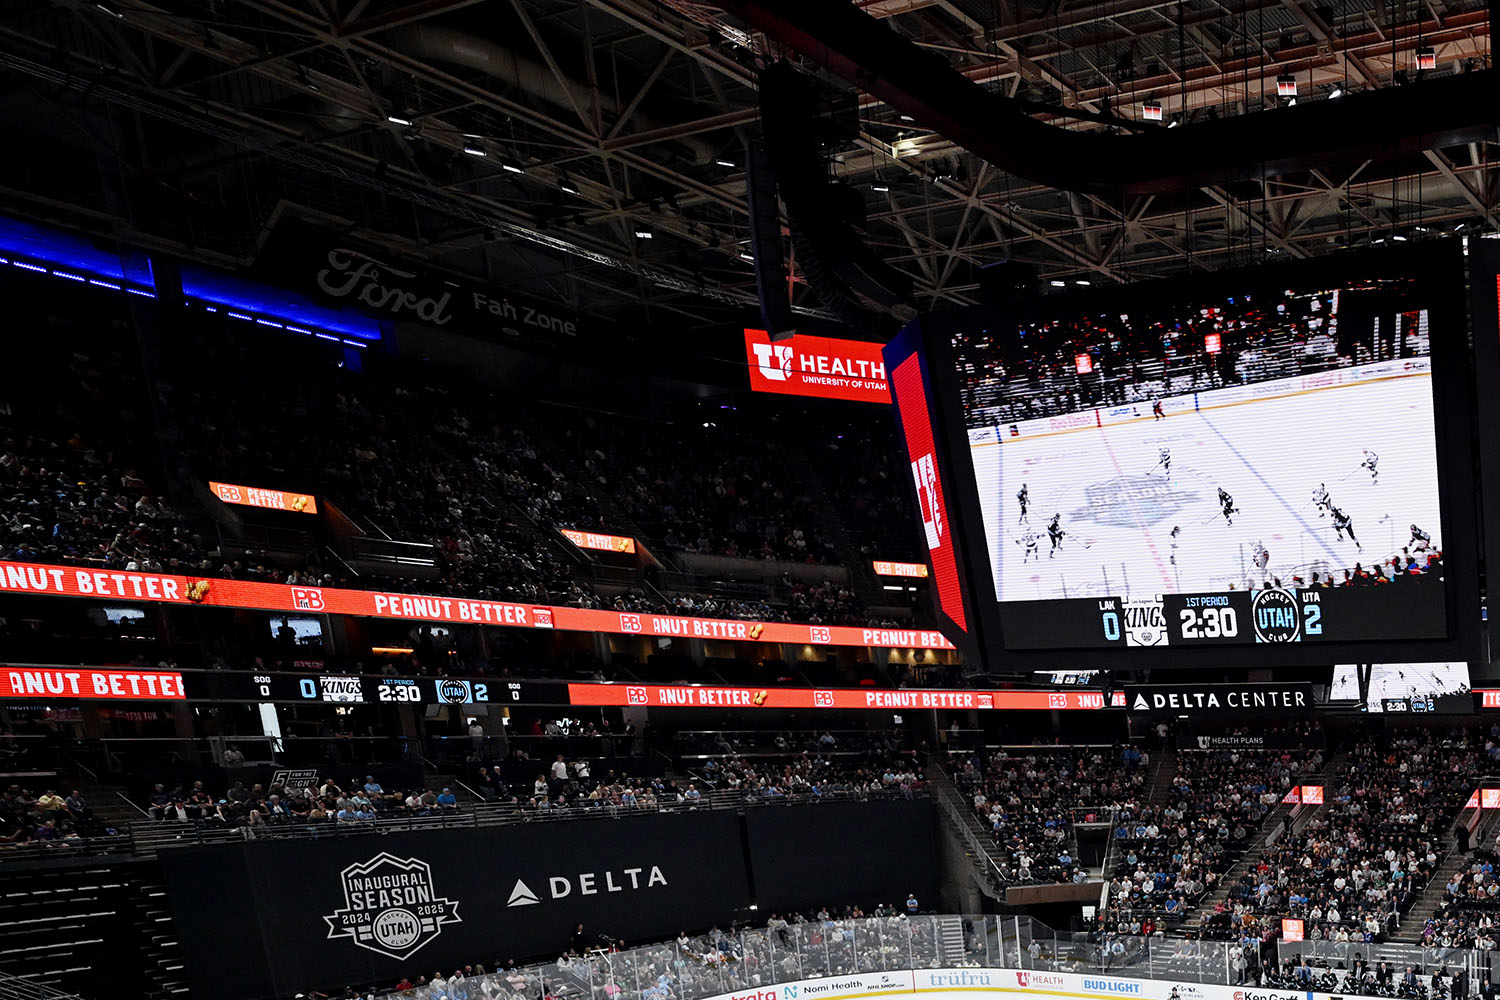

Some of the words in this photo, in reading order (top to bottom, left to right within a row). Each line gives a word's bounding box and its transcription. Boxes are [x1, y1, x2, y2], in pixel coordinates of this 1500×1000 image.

[317, 248, 451, 326] Ford
[473, 292, 517, 322] Fan
[522, 306, 577, 336] Zone
[800, 354, 886, 380] HEALTH
[802, 375, 850, 388] UNIVERSITY
[852, 380, 863, 389] OF
[864, 381, 887, 391] UTAH
[247, 488, 285, 503] PEANUT
[248, 497, 285, 510] BETTER
[587, 534, 612, 544] PEANUT
[78, 572, 178, 600] BETTER
[1099, 600, 1115, 610] LAK
[1186, 598, 1200, 607] 1ST
[1201, 596, 1229, 607] PERIOD
[1260, 592, 1291, 605] HOCKEY
[1302, 592, 1321, 603] UTA
[375, 595, 453, 619] PEANUT
[459, 601, 526, 624] BETTER
[1125, 606, 1167, 628] KINGS
[1180, 607, 1238, 639] 2:30
[1258, 607, 1295, 629] UTAH
[1304, 604, 1323, 635] 2
[653, 618, 696, 636] ANUT
[698, 620, 746, 639] BETTER
[1102, 612, 1121, 641] 0
[863, 630, 918, 646] PEANUT
[1268, 633, 1289, 642] CLUB
[9, 671, 80, 695] ANUT
[254, 676, 271, 684] SOG
[322, 680, 362, 694] KINGS
[260, 685, 270, 696] 0
[299, 679, 317, 698] 0
[378, 685, 421, 701] 2:30
[443, 687, 465, 697] UTAH
[474, 684, 488, 701] 2
[512, 691, 520, 700] 0
[658, 688, 697, 704] ANUT
[699, 689, 750, 706] BETTER
[866, 692, 918, 707] PEANUT
[922, 692, 972, 708] BETTER
[1154, 692, 1221, 709] DELTA
[1227, 690, 1306, 709] CENTER
[1387, 702, 1407, 711] 2:30
[1212, 736, 1237, 745] HEALTH
[1240, 737, 1264, 745] PLANS
[348, 872, 427, 892] INAUGURAL
[549, 865, 668, 899] DELTA
[351, 885, 430, 911] SEASON
[417, 903, 444, 916] 2025
[341, 912, 371, 925] 2024
[382, 913, 410, 923] HOCKEY
[380, 922, 415, 939] UTAH
[930, 971, 991, 987] trüfrü
[1032, 975, 1064, 986] HEALTH
[1083, 979, 1107, 992] BUD
[1107, 981, 1140, 994] LIGHT
[803, 984, 829, 995] Nomi
[831, 980, 863, 993] Health
